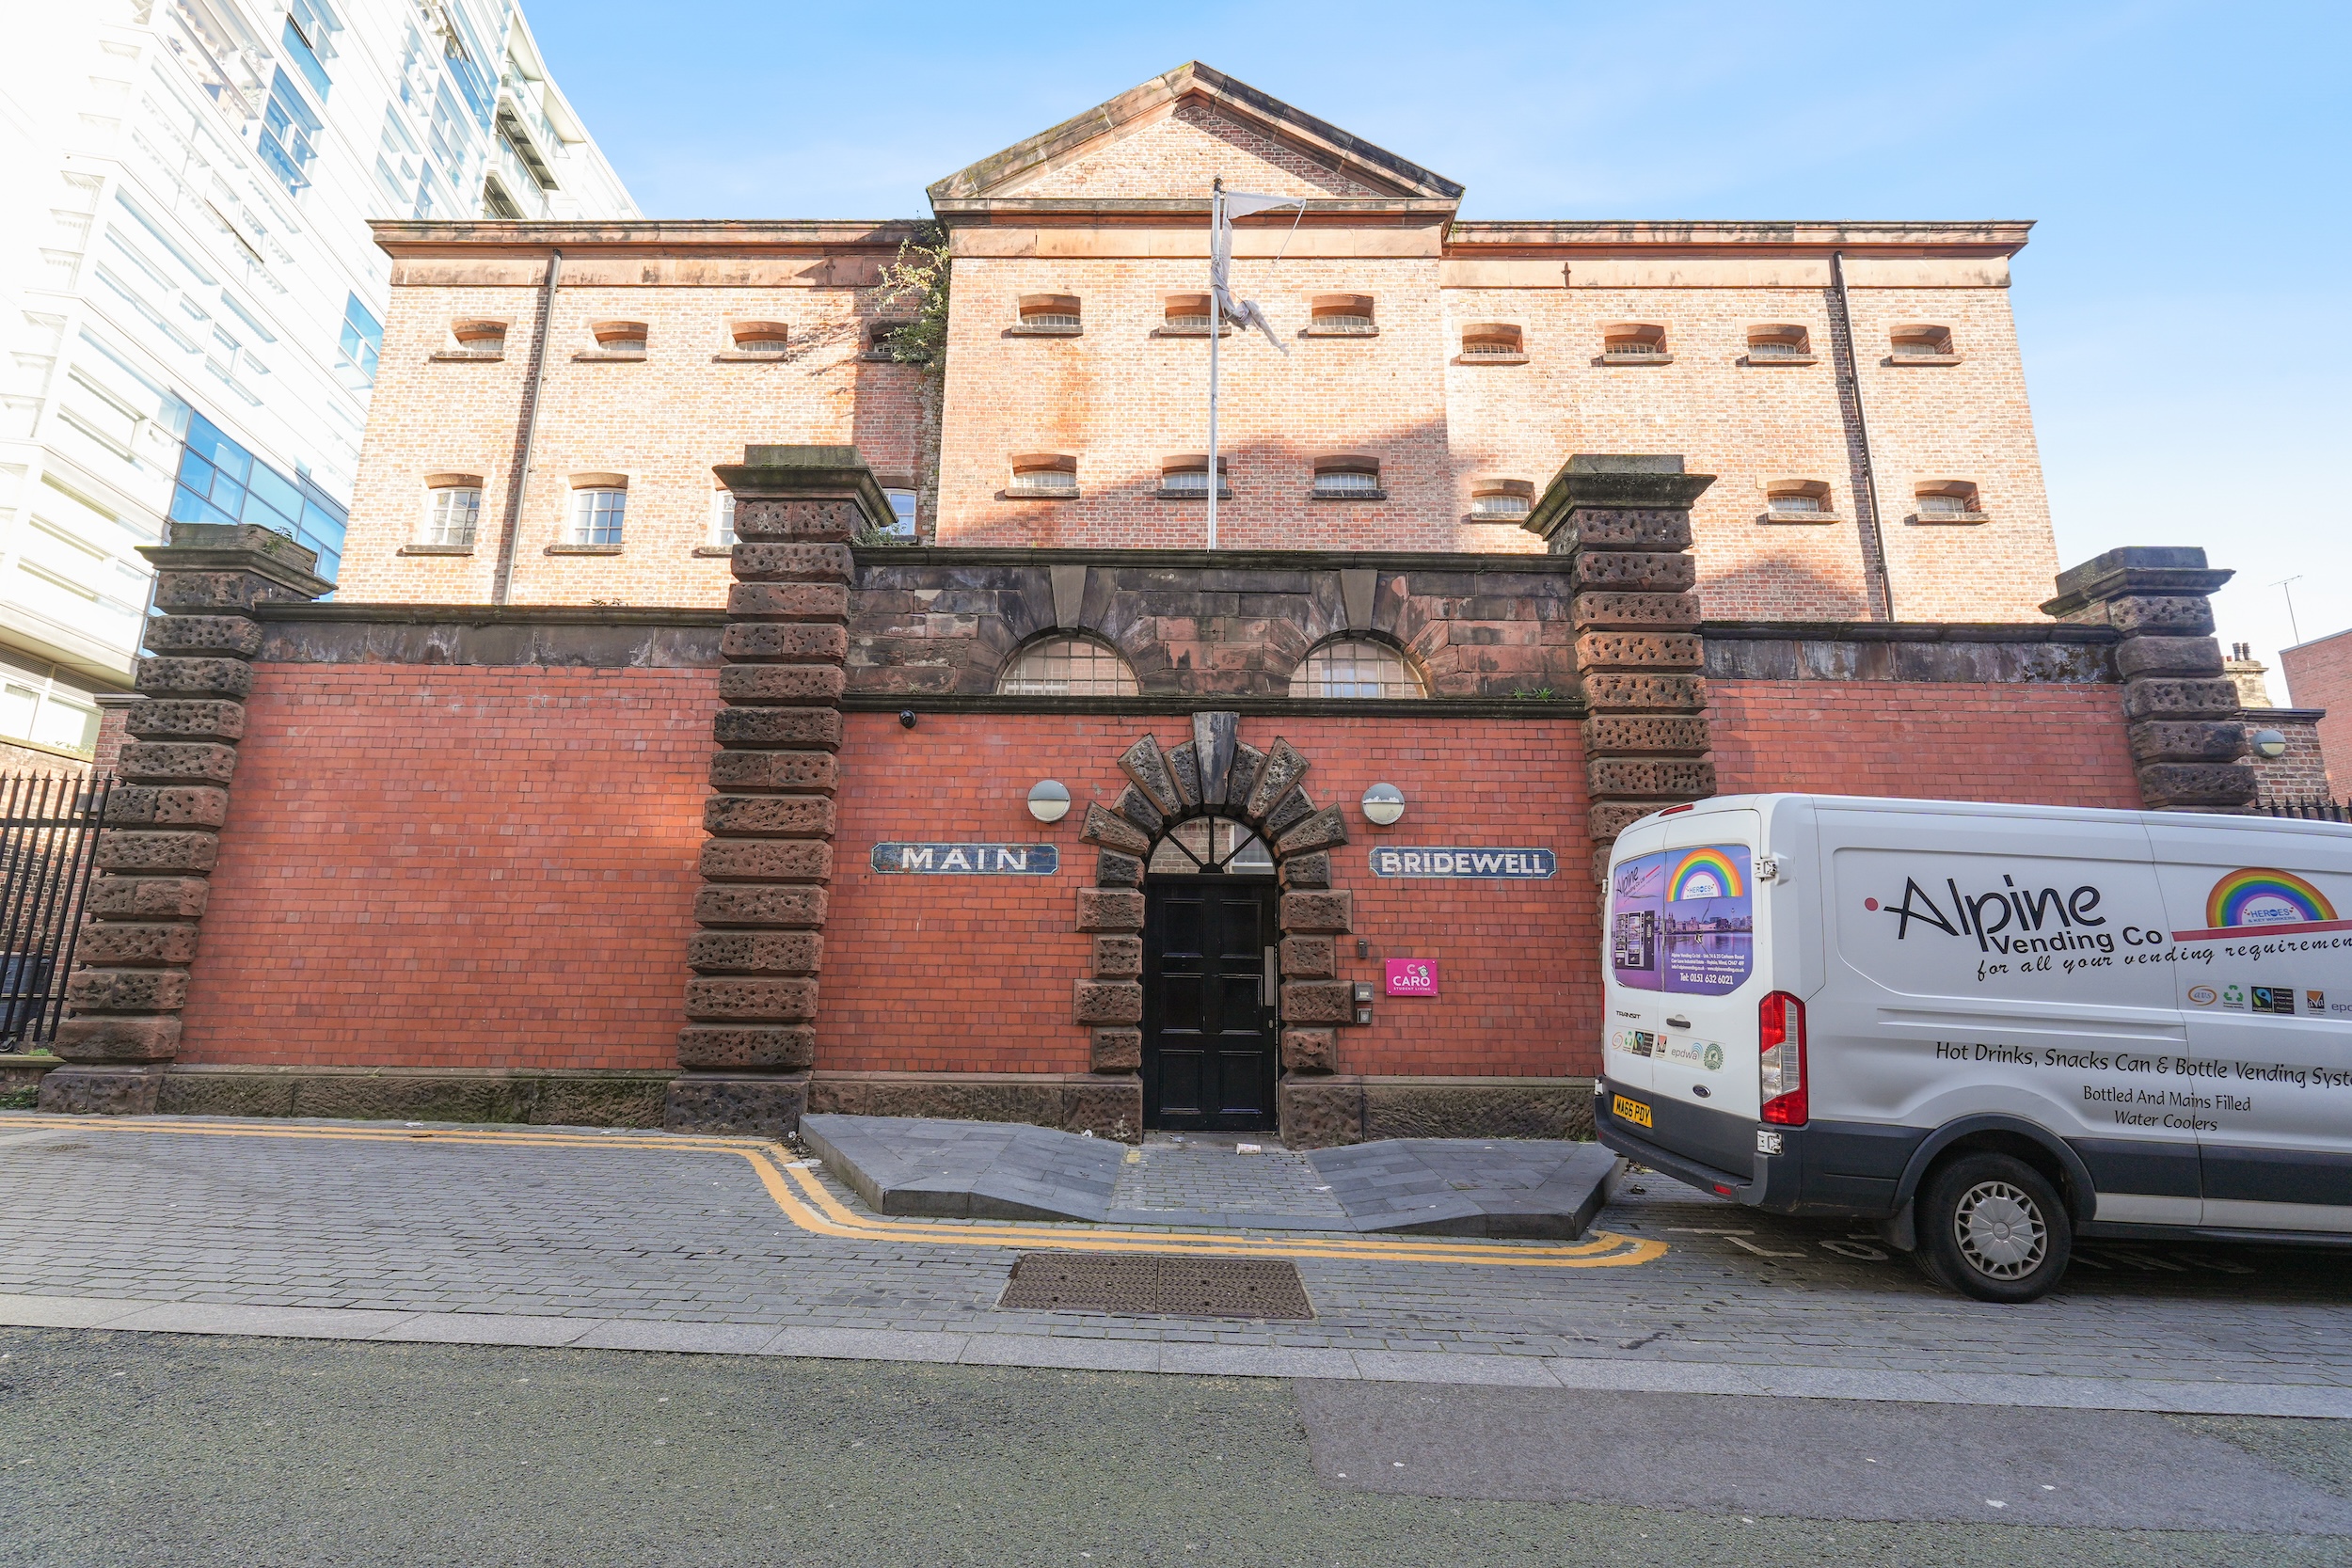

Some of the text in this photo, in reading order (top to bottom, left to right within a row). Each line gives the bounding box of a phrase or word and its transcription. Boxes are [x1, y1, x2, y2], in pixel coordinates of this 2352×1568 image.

[902, 848, 1027, 870] MAIN
[1381, 852, 1547, 874] BRIDEWELL
[1883, 875, 2106, 952] Alpine
[2250, 909, 2290, 918] HEROES
[1990, 927, 2163, 955] Vending Co
[1977, 959, 2010, 982] for
[2021, 955, 2053, 973] all
[2063, 954, 2113, 974] your
[2124, 946, 2215, 965] vending
[1392, 975, 1430, 987] CARO
[1690, 974, 1703, 982] 0151
[1705, 974, 1717, 983] 632
[1718, 974, 1733, 985] 6021
[1616, 1010, 1641, 1019] TRANSIT
[1671, 1049, 1698, 1060] epdwa
[1936, 1042, 2352, 1088] Hot Drinks, Snacks Can & Bottle Vending Syst
[2083, 1085, 2251, 1112] Bottled And Mains Filled
[1635, 1105, 1650, 1123] PDY
[2115, 1110, 2217, 1131] Water Coolers
